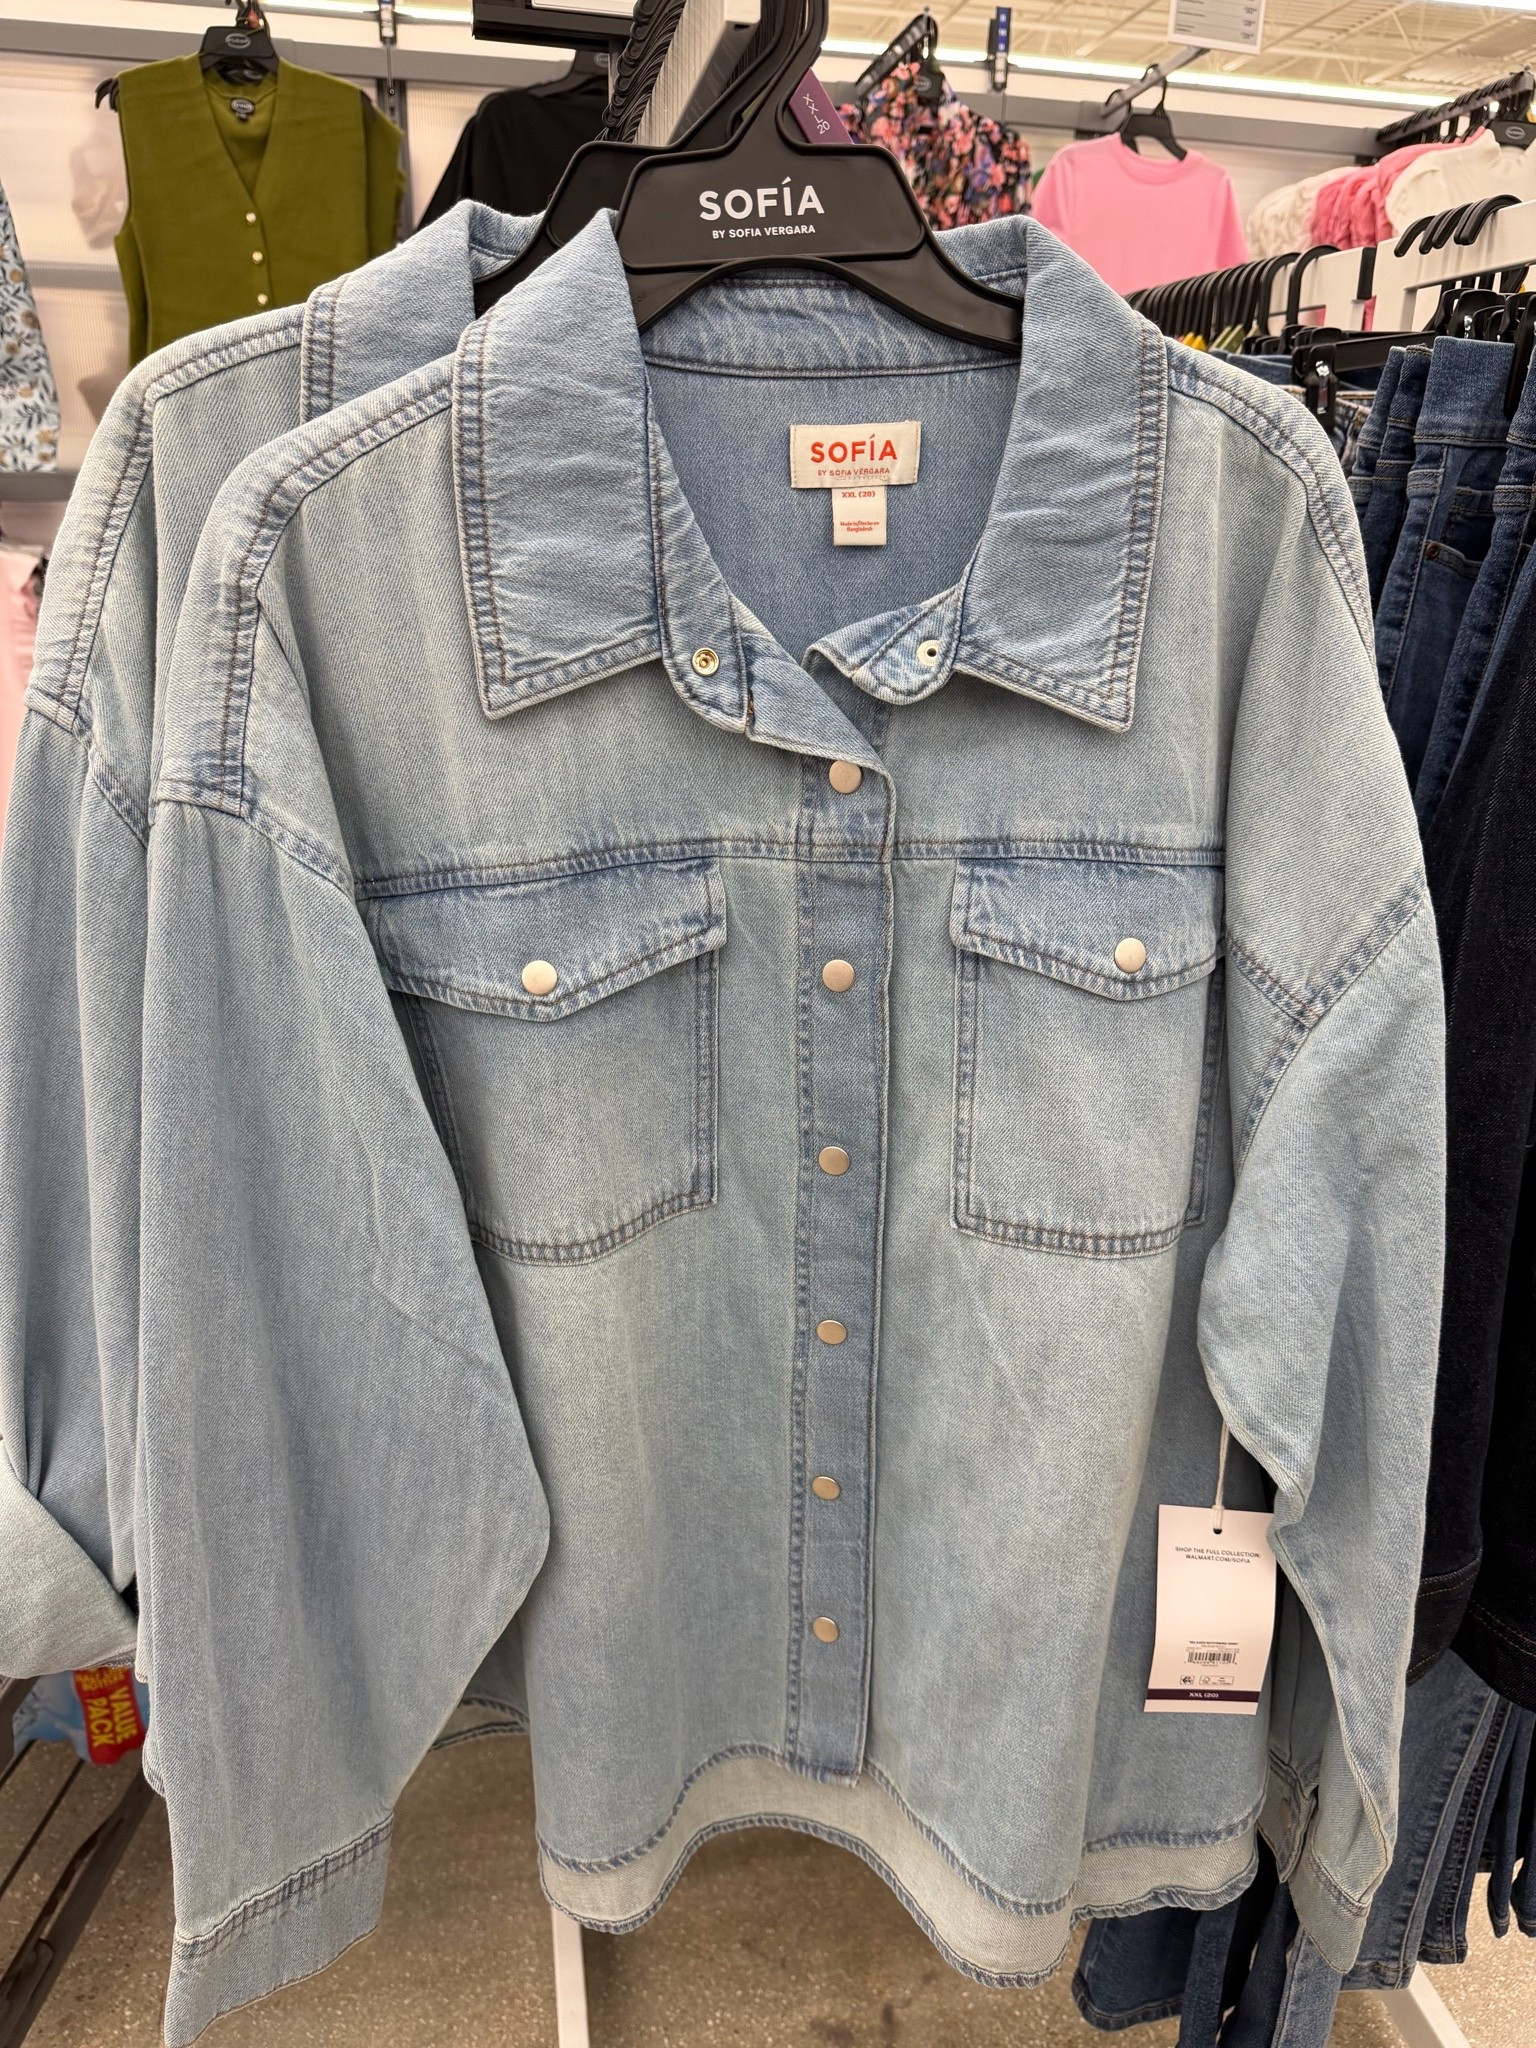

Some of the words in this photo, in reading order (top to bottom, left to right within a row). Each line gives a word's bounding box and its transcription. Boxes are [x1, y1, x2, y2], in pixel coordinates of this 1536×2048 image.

[816, 120, 831, 135] 20
[699, 176, 825, 221] SOFÍA
[712, 230, 726, 239] BY
[728, 228, 762, 238] SOFIA
[764, 225, 816, 236] VERGARA
[810, 433, 898, 464] SOFÍA
[853, 467, 890, 475] VERGARA
[858, 490, 876, 498] (20)
[1185, 1554, 1250, 1563] WALMART.COM/SOFIA
[85, 1697, 115, 1748] PACK
[109, 1686, 138, 1745] VALUE
